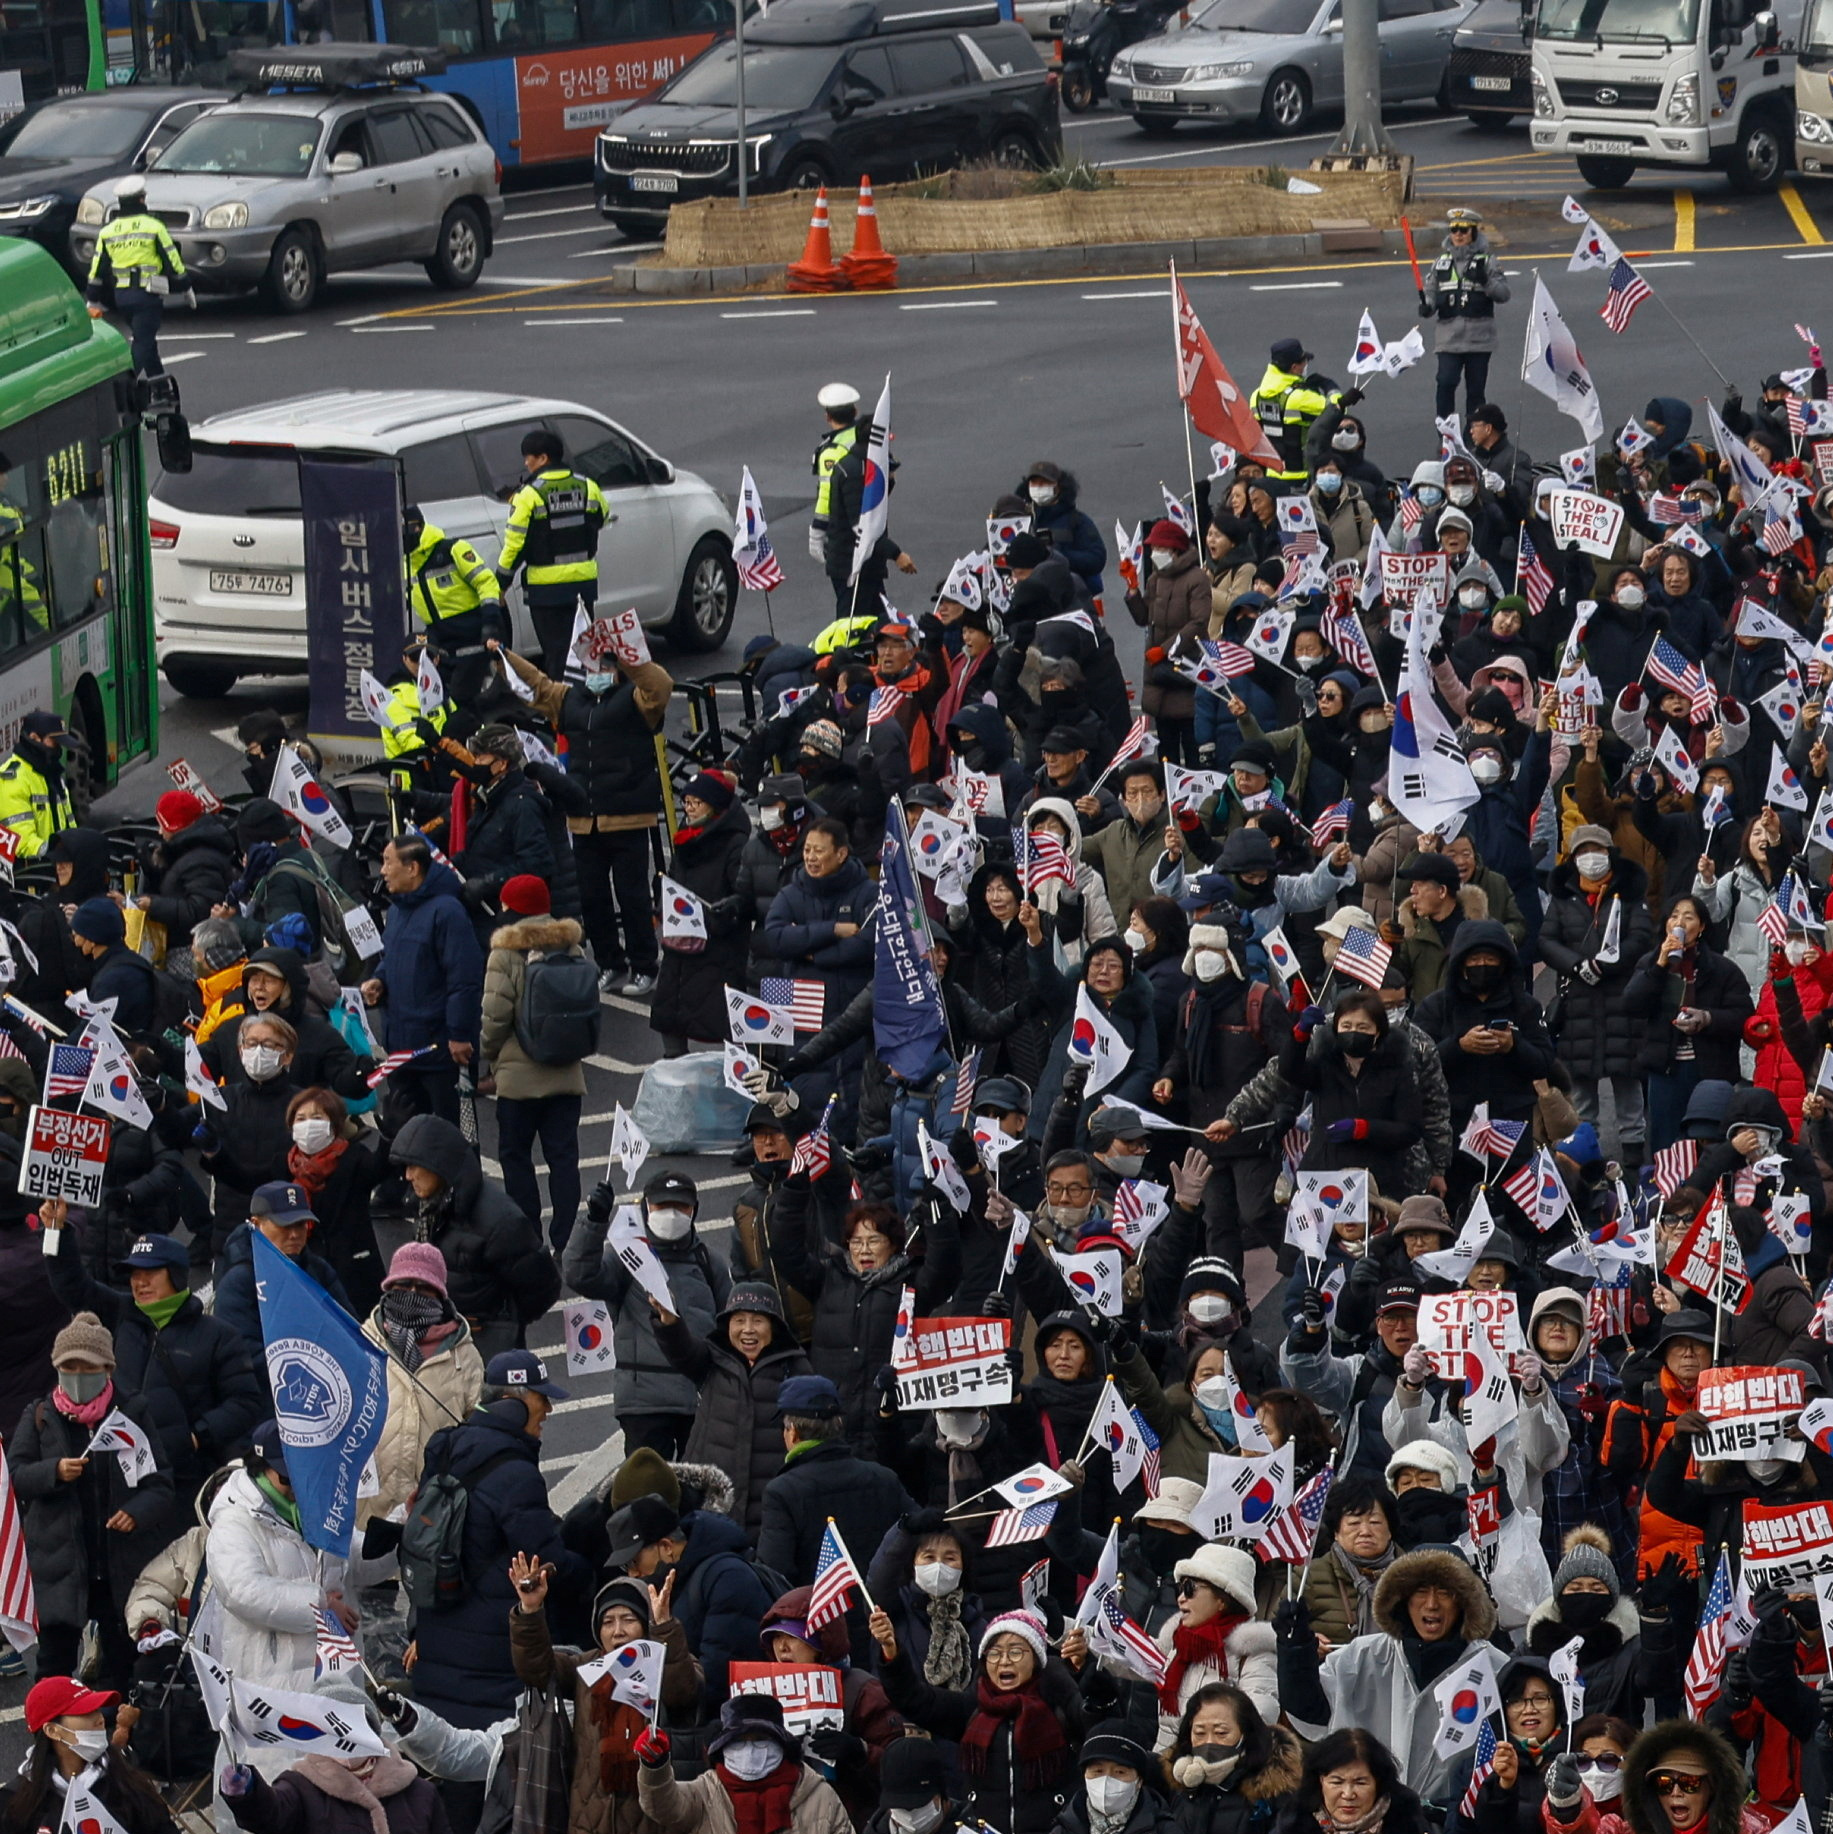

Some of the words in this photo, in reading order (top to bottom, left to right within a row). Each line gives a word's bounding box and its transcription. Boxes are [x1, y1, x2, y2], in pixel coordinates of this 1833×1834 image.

[560, 65, 610, 99] 당신을
[616, 58, 648, 90] 위한
[1563, 496, 1607, 516] STOP
[1565, 510, 1592, 527] THE
[1559, 524, 1600, 543] STEAL
[338, 521, 369, 573] 임시
[1387, 561, 1438, 576] STOP
[248, 576, 285, 592] 7476
[1402, 577, 1425, 588] THE
[36, 1111, 107, 1155] 부정선거
[50, 1146, 82, 1169] OUT
[28, 1162, 101, 1206] 입법독재
[1431, 1298, 1515, 1323] STOP
[1440, 1324, 1504, 1351] THE
[896, 1363, 1009, 1407] 이재명구속
[1699, 1373, 1800, 1417] 탄핵반대
[1694, 1417, 1800, 1458] 이재명구
